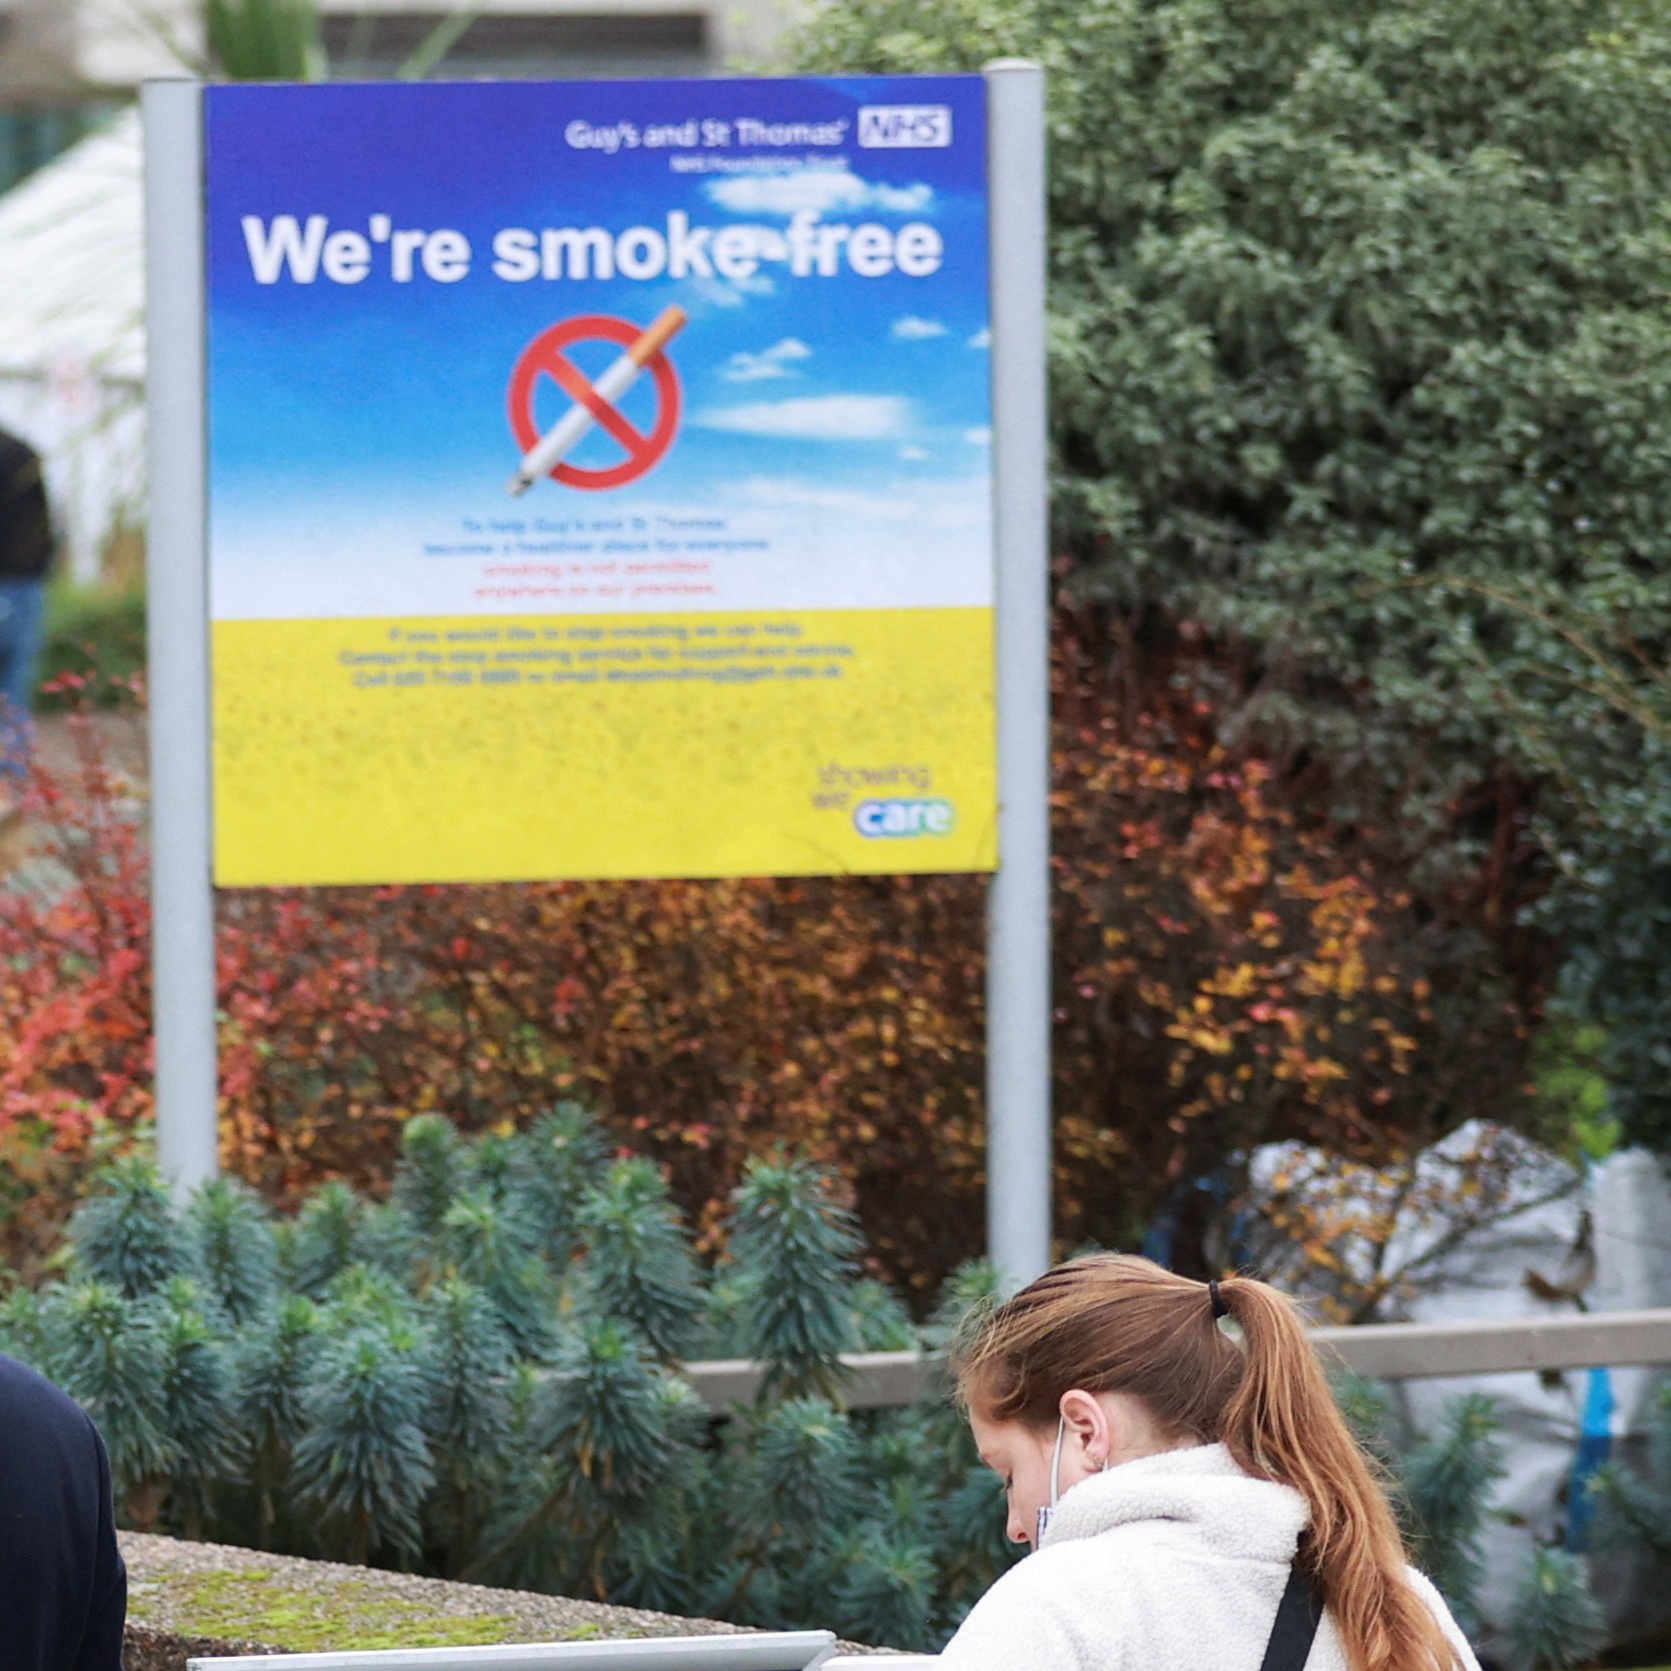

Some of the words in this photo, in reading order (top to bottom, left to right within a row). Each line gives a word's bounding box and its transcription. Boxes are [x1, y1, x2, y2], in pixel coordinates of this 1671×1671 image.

[564, 120, 640, 154] Guy's
[642, 119, 699, 148] and
[702, 118, 731, 148] St
[861, 111, 944, 146] NHS
[242, 215, 469, 285] We're
[492, 209, 942, 282] smoke-free
[856, 802, 951, 832] care
